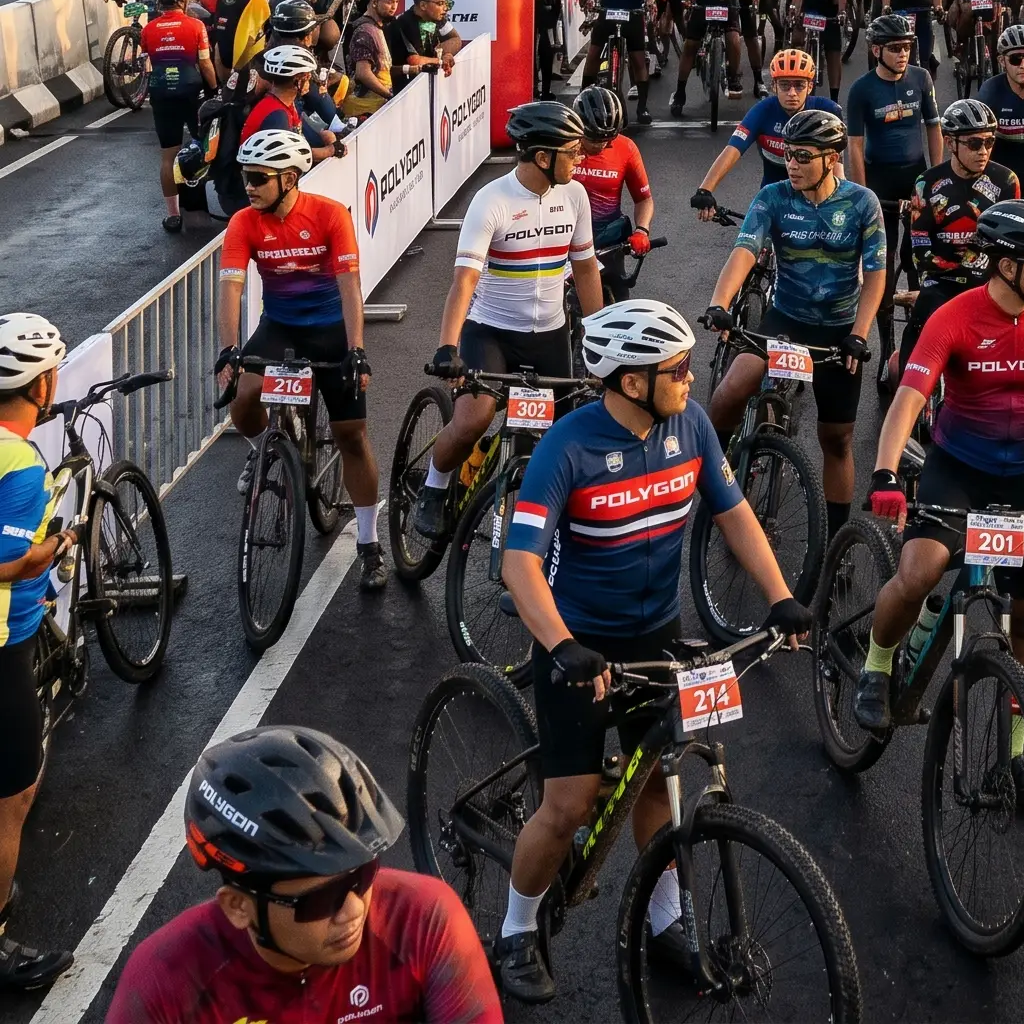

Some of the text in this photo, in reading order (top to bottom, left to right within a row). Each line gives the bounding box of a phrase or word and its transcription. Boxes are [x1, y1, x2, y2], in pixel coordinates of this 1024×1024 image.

[380, 138, 425, 203] POLYGON
[272, 378, 303, 394] 216
[516, 401, 547, 418] 302
[590, 471, 695, 510] POLYGON
[978, 532, 1013, 553] 201
[693, 683, 730, 713] 214
[199, 779, 260, 838] POLYGON
